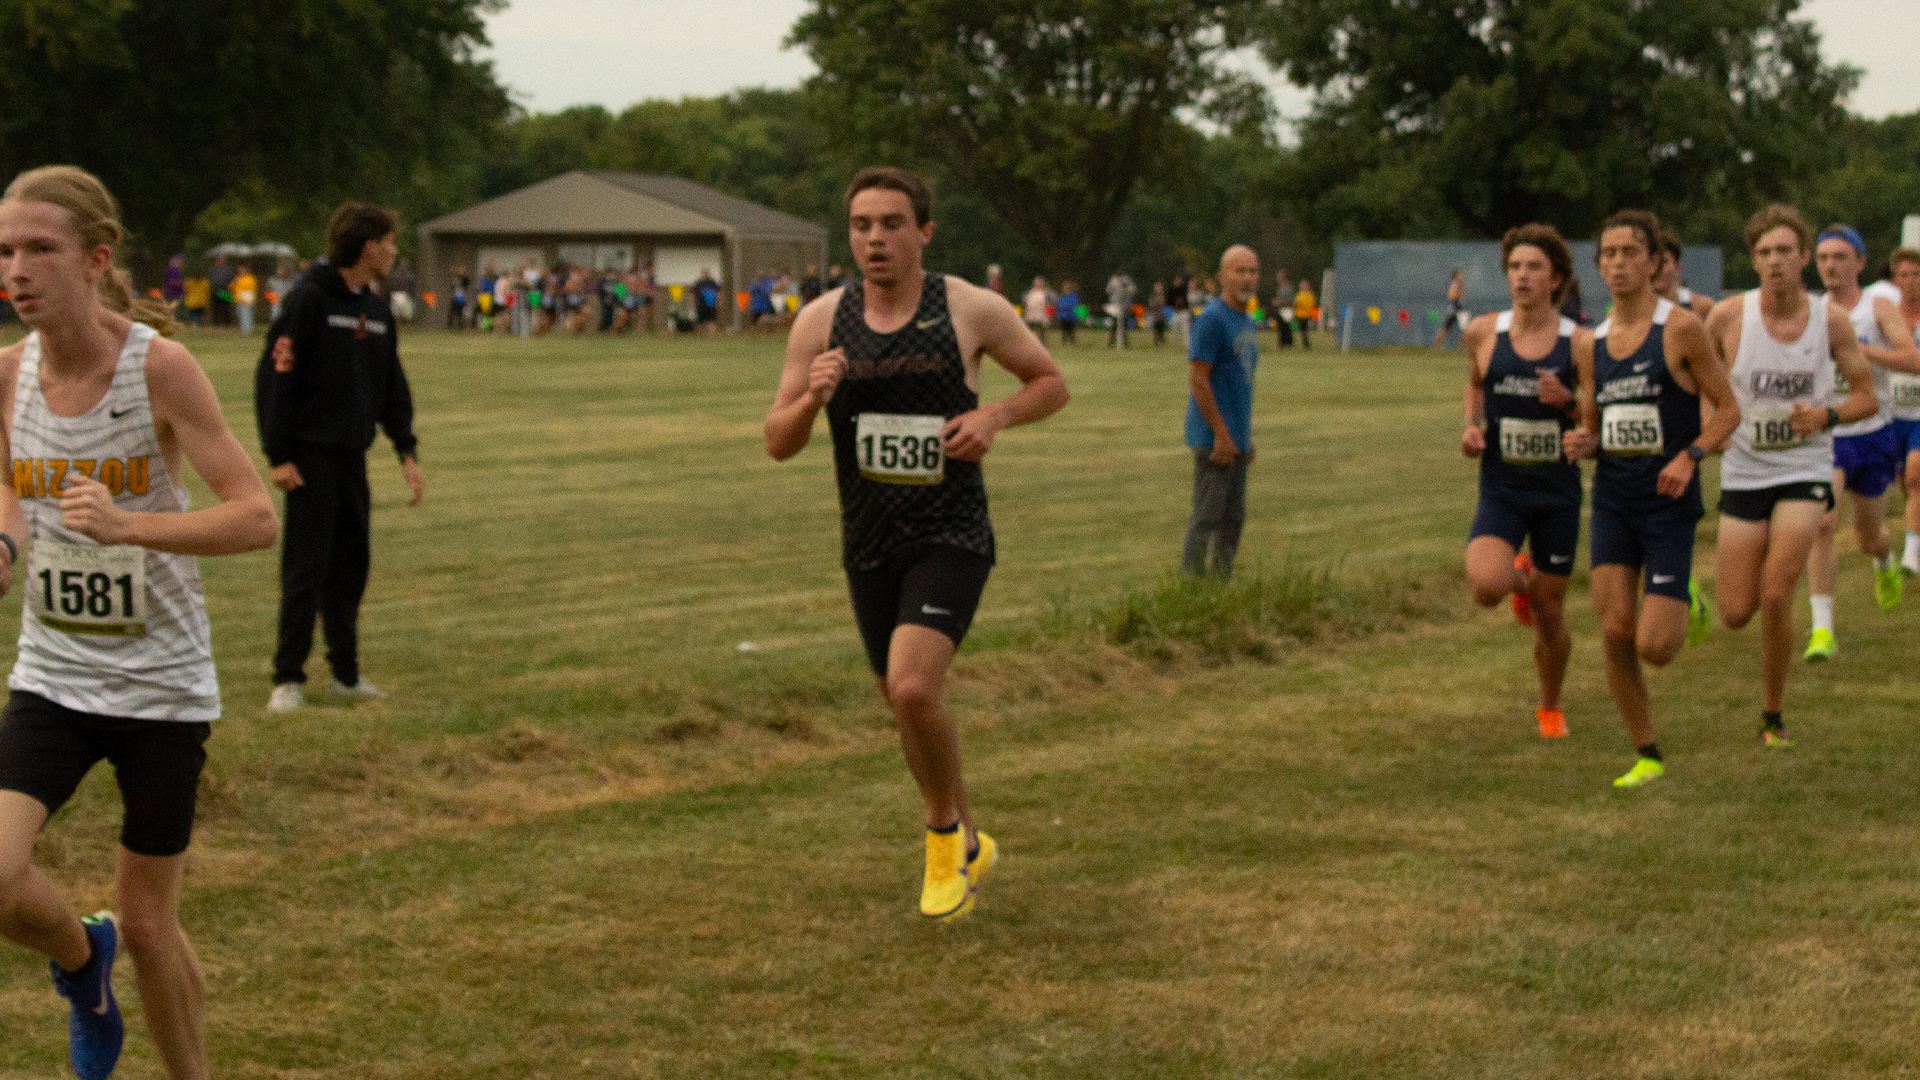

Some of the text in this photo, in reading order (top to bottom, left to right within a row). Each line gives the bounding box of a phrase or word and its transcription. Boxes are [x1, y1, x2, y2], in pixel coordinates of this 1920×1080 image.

[1606, 420, 1659, 446] 1555
[1755, 419, 1810, 446] 160
[863, 435, 940, 469] 1536
[38, 568, 134, 617] 1581
